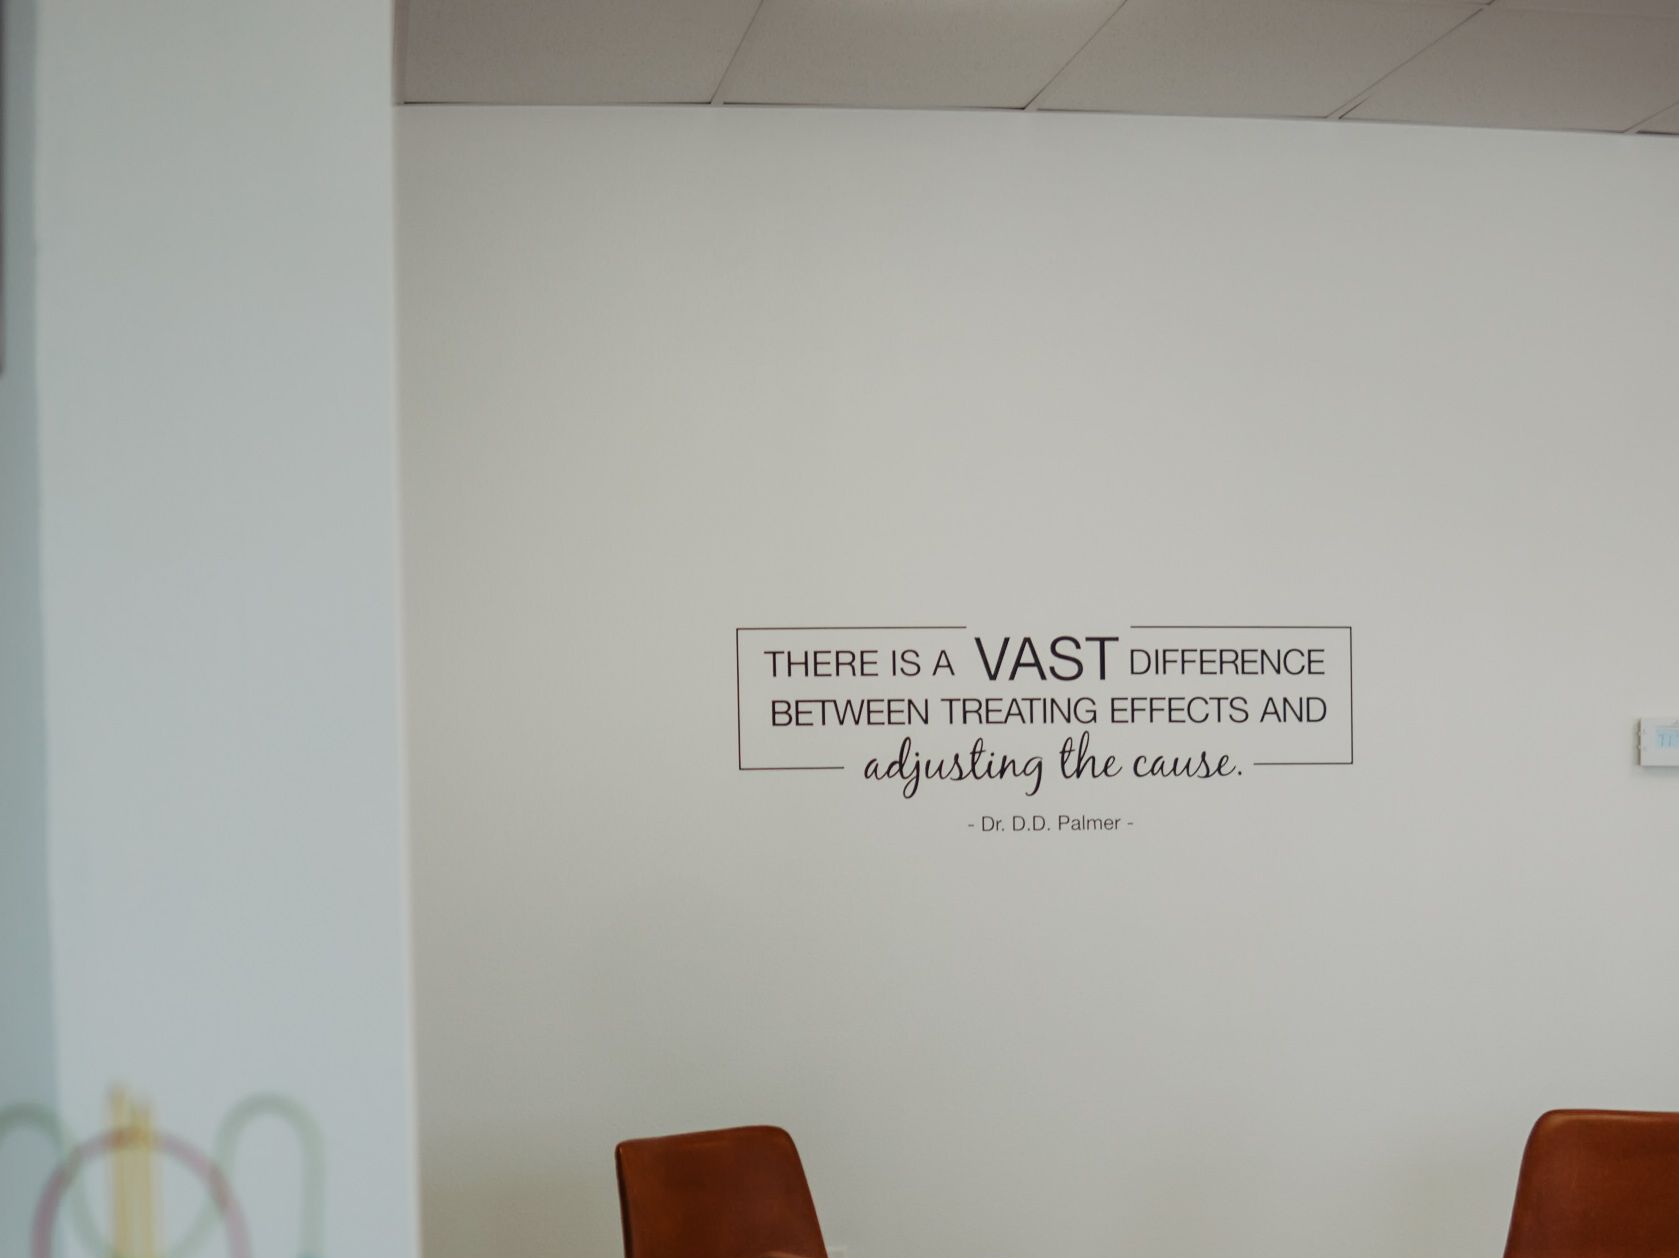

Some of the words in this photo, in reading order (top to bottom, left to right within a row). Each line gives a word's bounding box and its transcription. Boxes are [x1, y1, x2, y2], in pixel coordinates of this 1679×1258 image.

[764, 650, 878, 677] THERE
[892, 649, 921, 677] IS
[932, 650, 955, 676] A
[974, 636, 1119, 681] VAST
[1130, 648, 1325, 675] DIFFERENCE
[772, 698, 928, 727] BETWEEN
[940, 697, 1097, 724] TREATING
[1111, 696, 1249, 723] EFFECTS
[1260, 697, 1327, 723] AND
[864, 736, 1043, 799] adjusting
[1059, 730, 1123, 779] the
[1133, 751, 1242, 779] cause.
[982, 816, 1004, 832] Dr.
[1013, 815, 1050, 831] D.D.
[1059, 814, 1121, 831] Palmer
